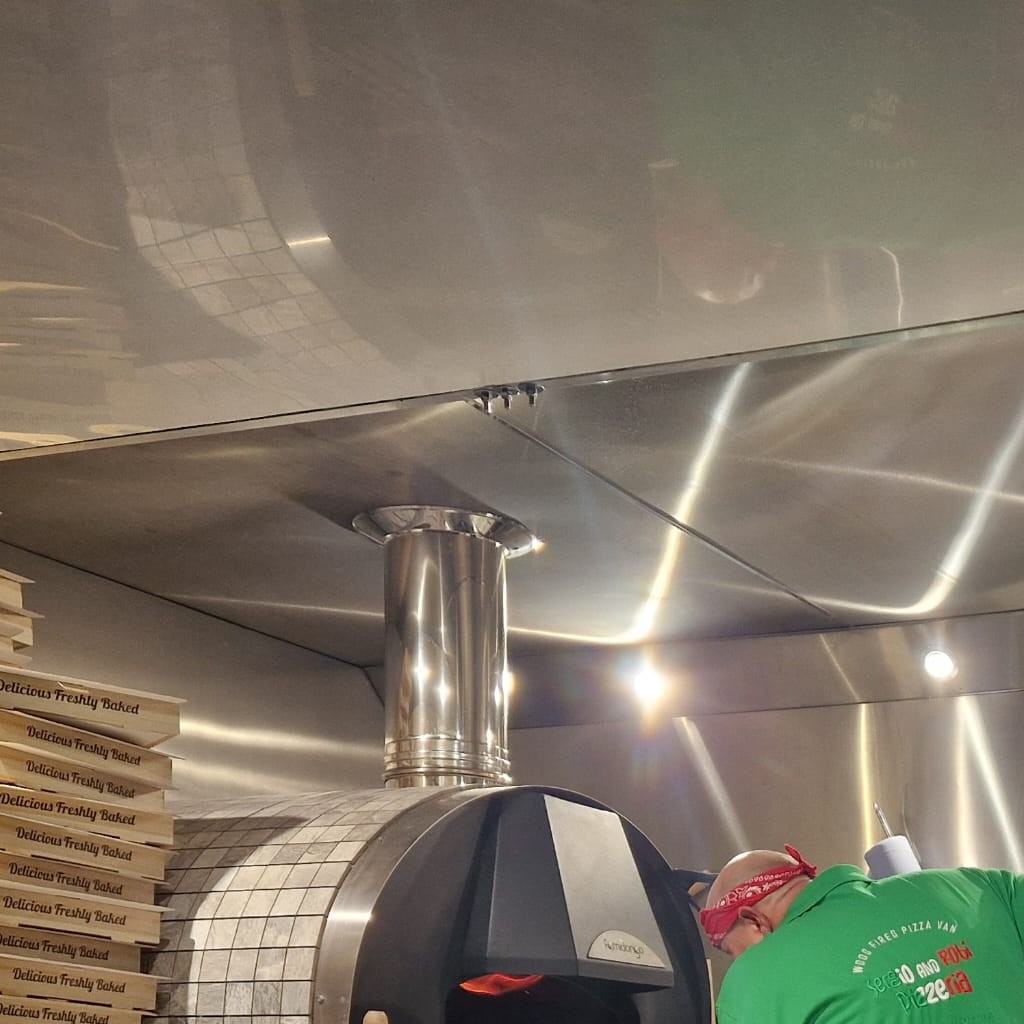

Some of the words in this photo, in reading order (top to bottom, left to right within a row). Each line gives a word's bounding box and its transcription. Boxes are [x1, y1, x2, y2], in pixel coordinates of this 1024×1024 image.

[54, 689, 98, 710] Freshly
[101, 697, 140, 714] Baked
[27, 725, 72, 747] Delicious
[74, 738, 109, 760] Freshly
[111, 749, 141, 765] Baked
[26, 760, 69, 781] Delicious
[71, 772, 105, 793] Freshly
[107, 781, 135, 798] Baked
[0, 793, 53, 811] Delicious
[56, 802, 97, 821] Freshly
[99, 809, 136, 825] Baked
[16, 827, 62, 846] Delicious
[64, 837, 100, 857] Freshly
[102, 845, 132, 860] Baked
[9, 863, 54, 882] Delicious
[56, 872, 91, 891] Freshly
[93, 880, 123, 895] Baked
[3, 896, 52, 914] Delicious
[55, 904, 91, 923] Freshly
[94, 910, 127, 925] Baked
[0, 932, 39, 950] elicious
[42, 940, 77, 959] Freshly
[79, 946, 110, 960] Baked
[852, 948, 872, 973] WOOD
[868, 930, 898, 949] FIRED
[901, 920, 932, 935] PIZZA
[937, 920, 957, 934] VAN
[12, 968, 58, 984] Delicious
[60, 974, 95, 992] Freshly
[96, 979, 126, 993] Baked
[916, 959, 940, 978] AND
[42, 1008, 77, 1024] Freshly
